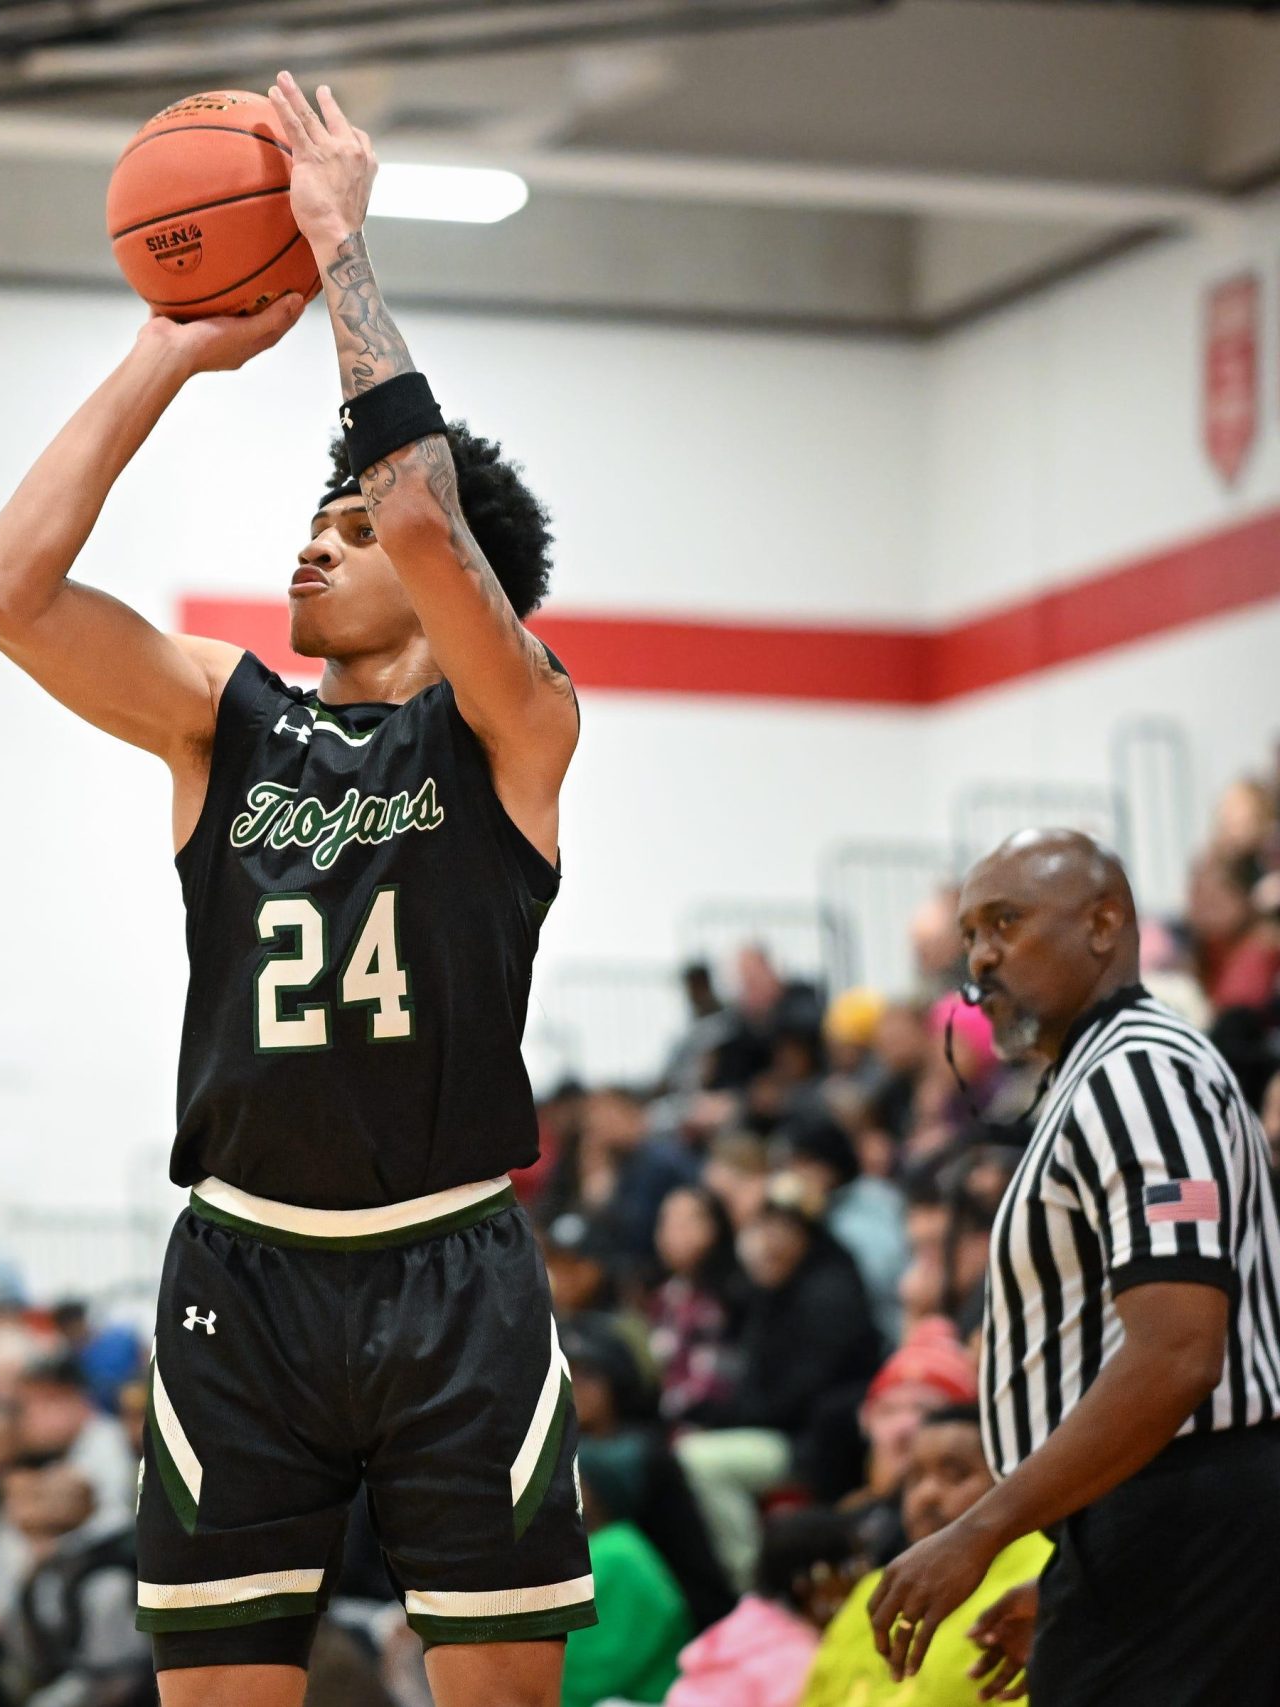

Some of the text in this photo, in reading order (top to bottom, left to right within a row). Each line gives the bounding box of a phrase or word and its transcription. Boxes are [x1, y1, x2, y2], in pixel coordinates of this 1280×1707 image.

[146, 227, 190, 253] NFHS
[229, 777, 445, 870] Trojans
[253, 884, 416, 1054] 24
